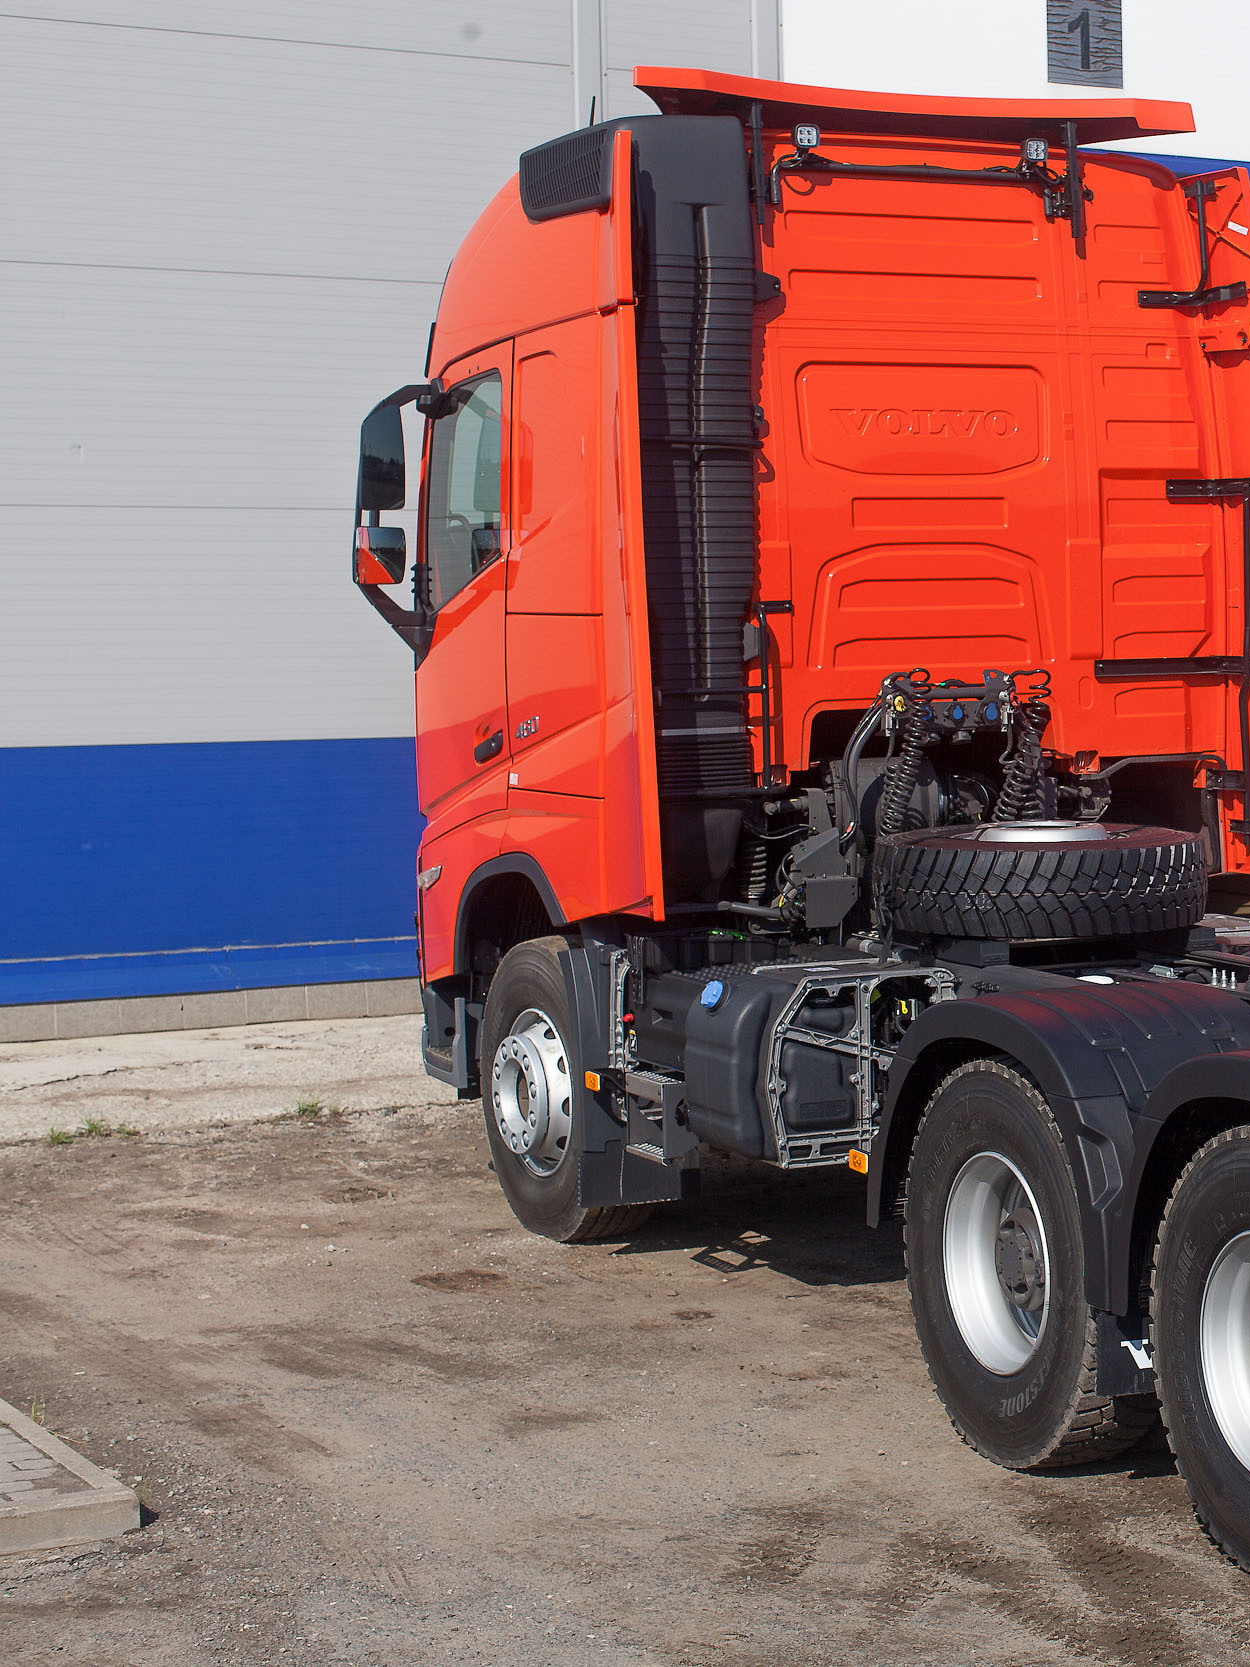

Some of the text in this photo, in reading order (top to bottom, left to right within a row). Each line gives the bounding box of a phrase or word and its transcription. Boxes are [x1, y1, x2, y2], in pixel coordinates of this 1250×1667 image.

[1068, 11, 1090, 69] 1
[829, 408, 1018, 438] VOLVO
[515, 716, 540, 740] 460
